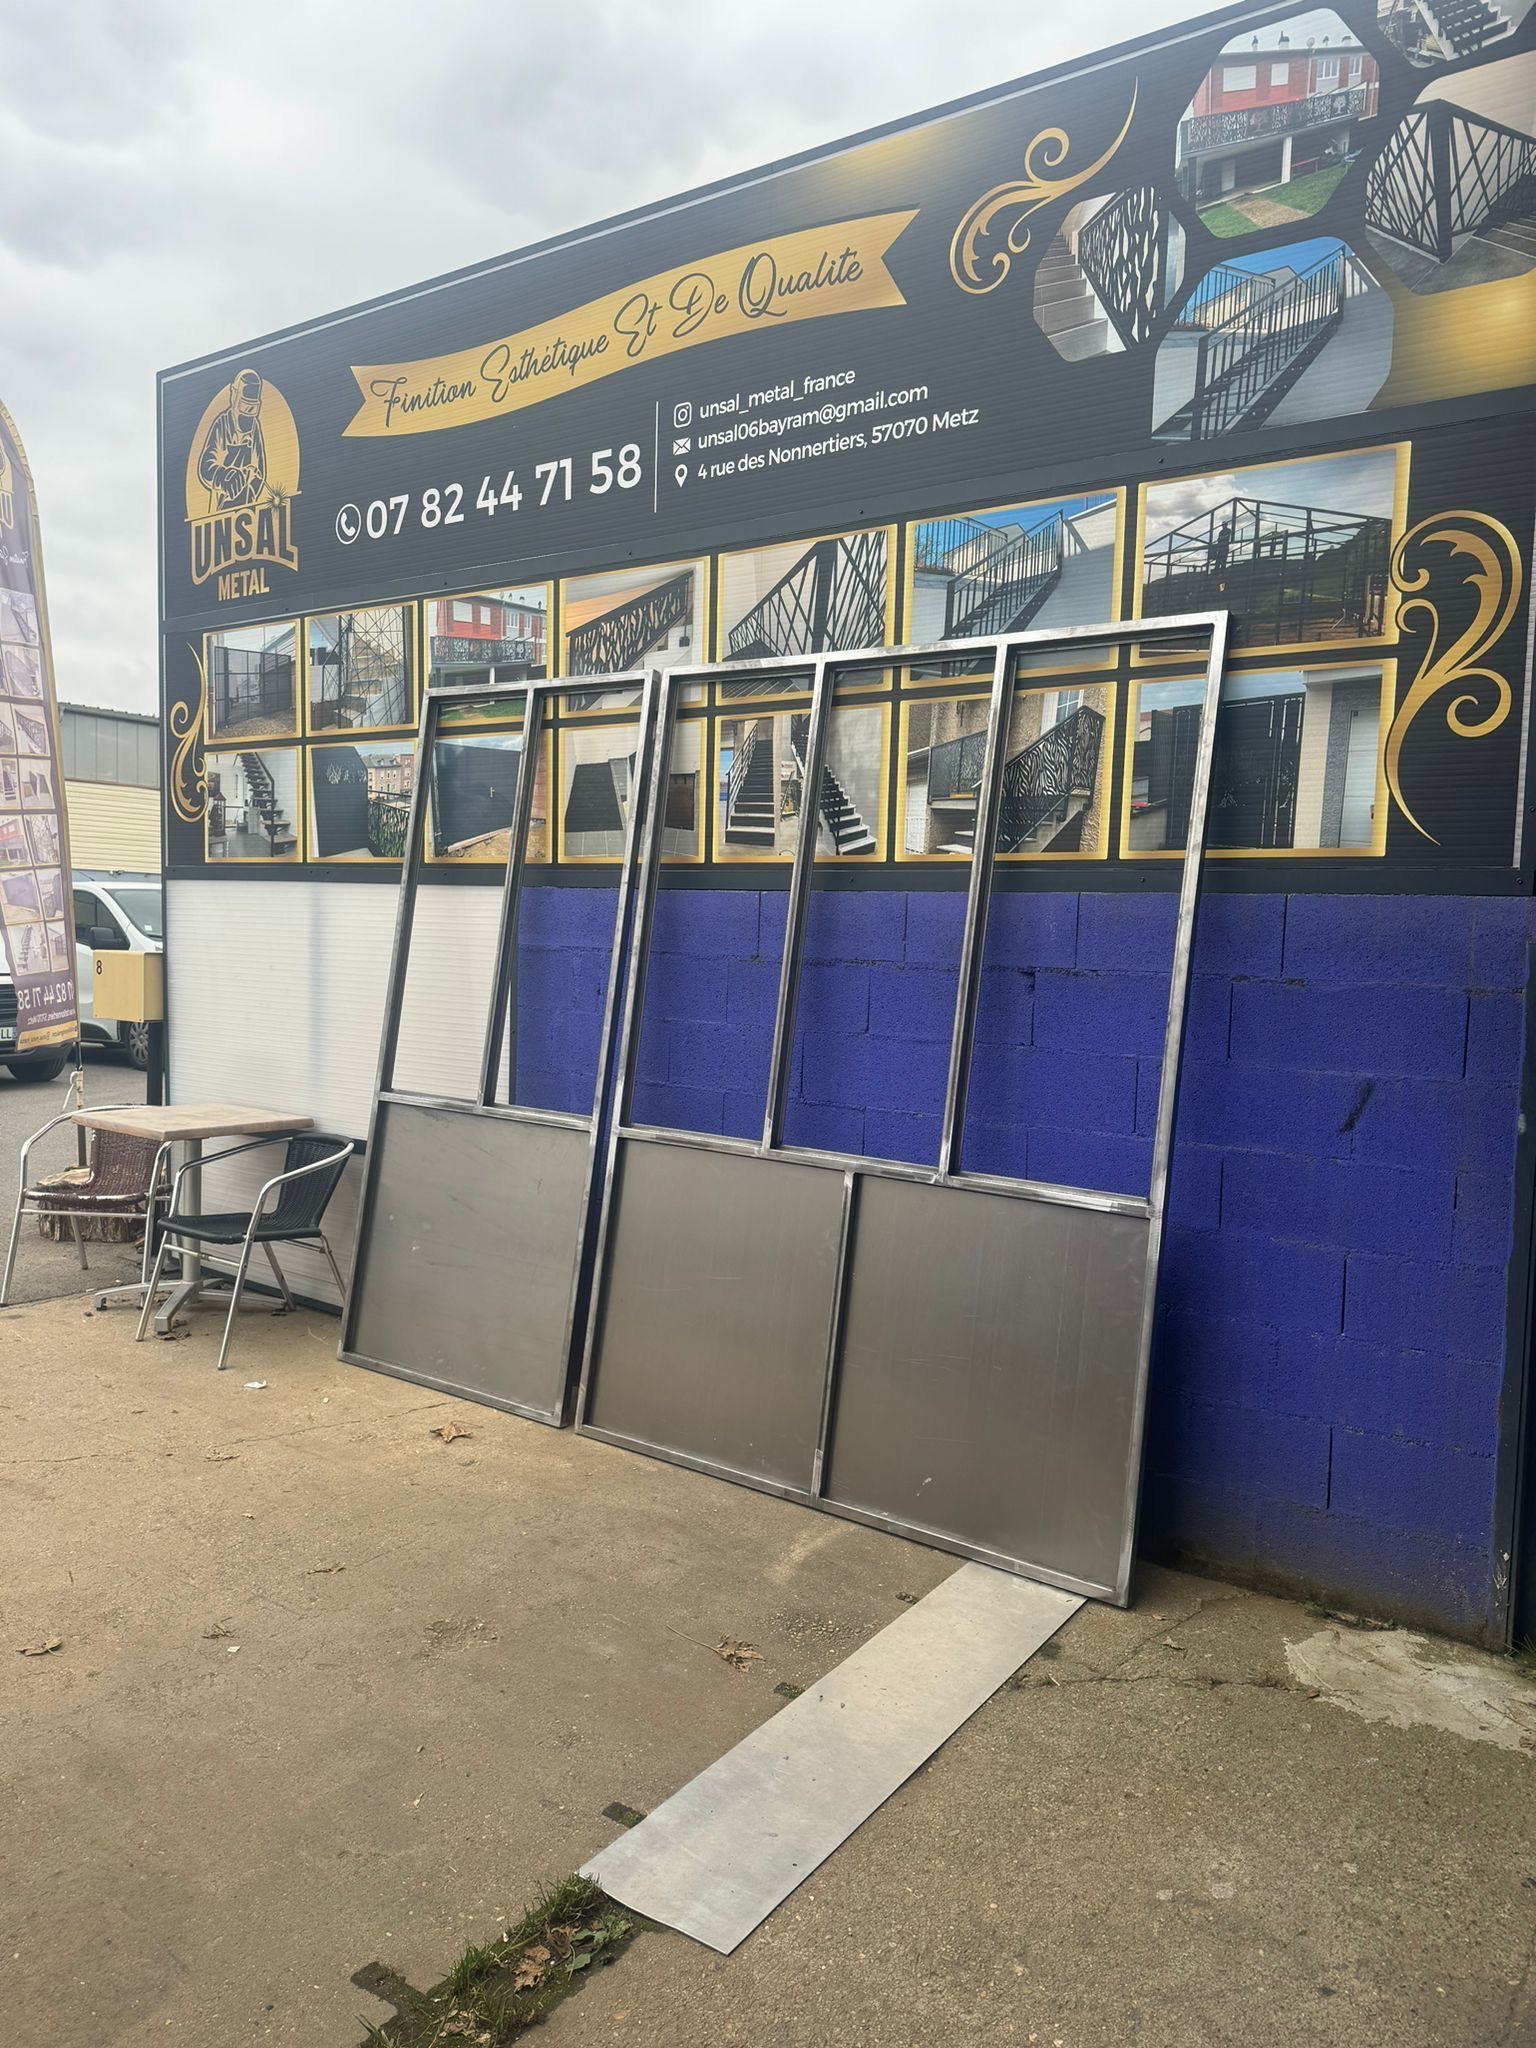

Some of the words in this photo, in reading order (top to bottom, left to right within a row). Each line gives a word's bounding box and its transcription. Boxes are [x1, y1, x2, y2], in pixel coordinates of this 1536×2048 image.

[370, 377, 476, 428] Finition
[480, 334, 609, 403] Esthétique
[613, 292, 663, 357] Et
[668, 272, 730, 338] De
[738, 246, 864, 319] Qualité
[698, 383, 928, 449] unsal06bayram@gmail.com
[699, 368, 856, 419] unsal_metal_france
[697, 464, 708, 480] 4
[710, 459, 735, 478] rue
[737, 452, 765, 473] des
[768, 430, 868, 467] Nonnertiers,
[871, 416, 928, 444] 57070
[931, 407, 979, 433] Metz
[366, 493, 410, 539] 07
[420, 482, 465, 528] 82
[475, 470, 523, 516] 44
[534, 457, 573, 506] 71
[589, 443, 642, 495] 58
[191, 498, 299, 585] UNSAL
[218, 567, 270, 601] METAL
[96, 959, 103, 975] 8
